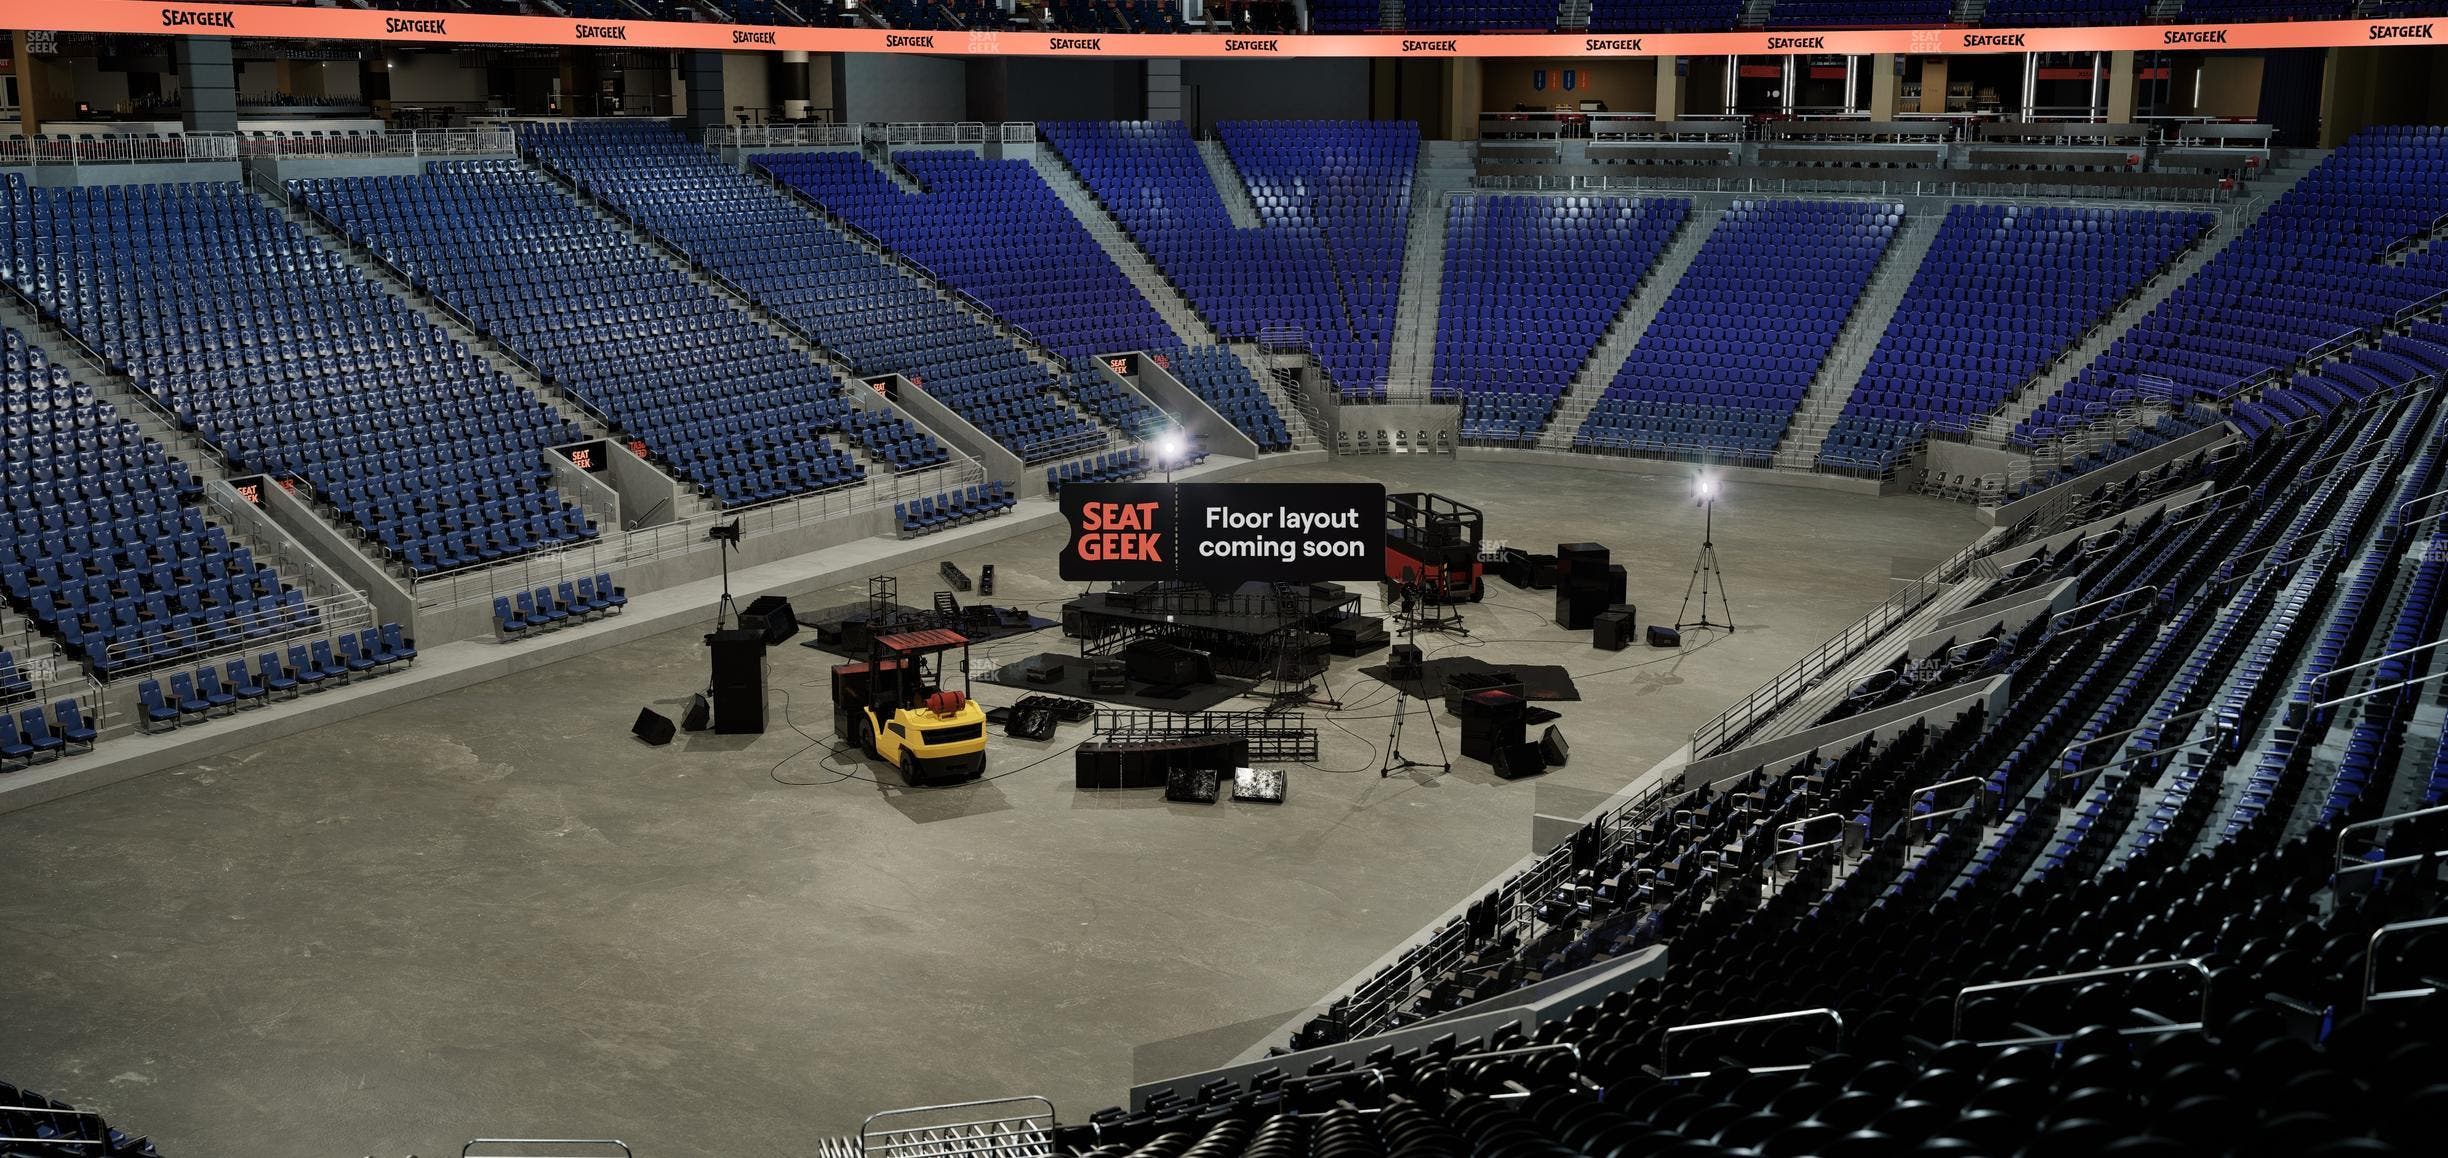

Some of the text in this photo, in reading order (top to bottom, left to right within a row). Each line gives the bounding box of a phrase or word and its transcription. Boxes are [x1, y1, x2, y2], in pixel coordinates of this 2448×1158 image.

[162, 9, 235, 28] SEATGEEK
[386, 18, 446, 34] SEATGEEK
[576, 24, 627, 40] SEATGEEK
[2369, 24, 2433, 39] SEATGEEK
[733, 31, 776, 44] SEATGEEK
[887, 35, 934, 48] SEATGEEK
[1768, 37, 1825, 49] SEATGEEK
[1964, 34, 2025, 47] SEATGEEK
[2164, 30, 2228, 44] SEATGEEK
[1050, 38, 1101, 51] SEATGEEK
[1225, 40, 1278, 52] SEATGEEK
[1403, 40, 1457, 52] SEATGEEK
[1586, 39, 1642, 51] SEATGEEK
